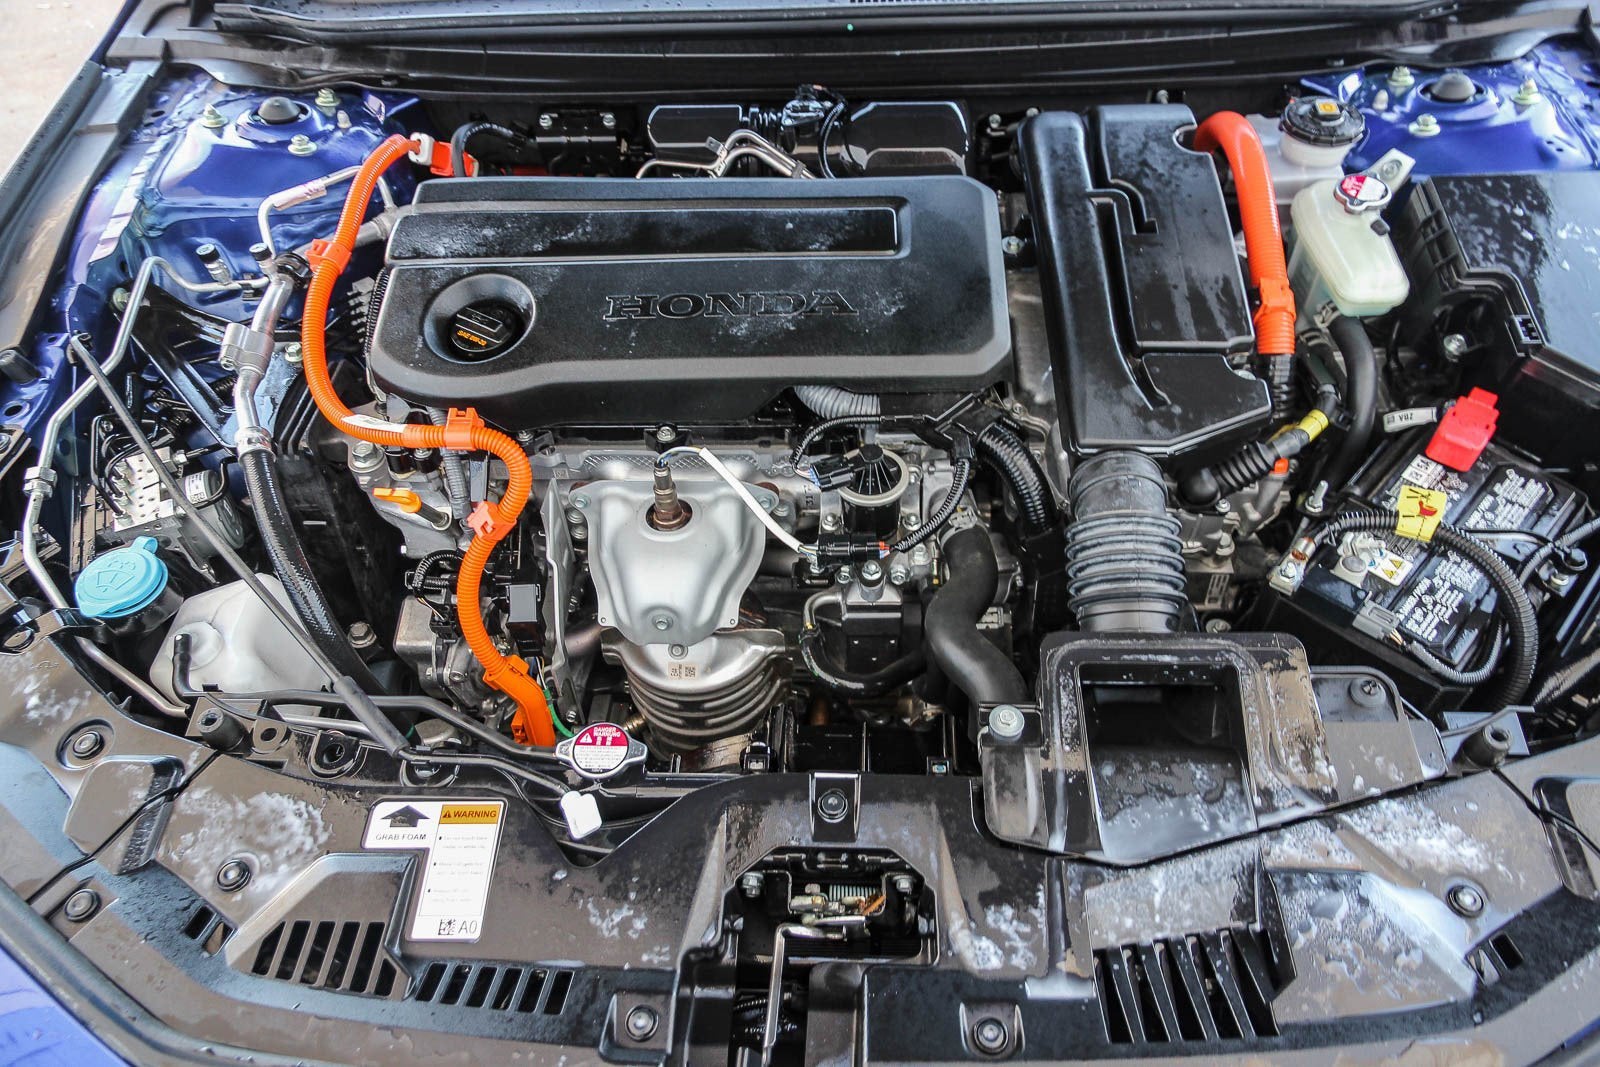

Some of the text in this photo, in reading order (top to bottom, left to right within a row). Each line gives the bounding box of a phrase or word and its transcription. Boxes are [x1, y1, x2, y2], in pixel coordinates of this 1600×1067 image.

[602, 289, 859, 321] HONDA
[453, 810, 497, 819] WARNING
[375, 833, 427, 841] GRAB FOAM
